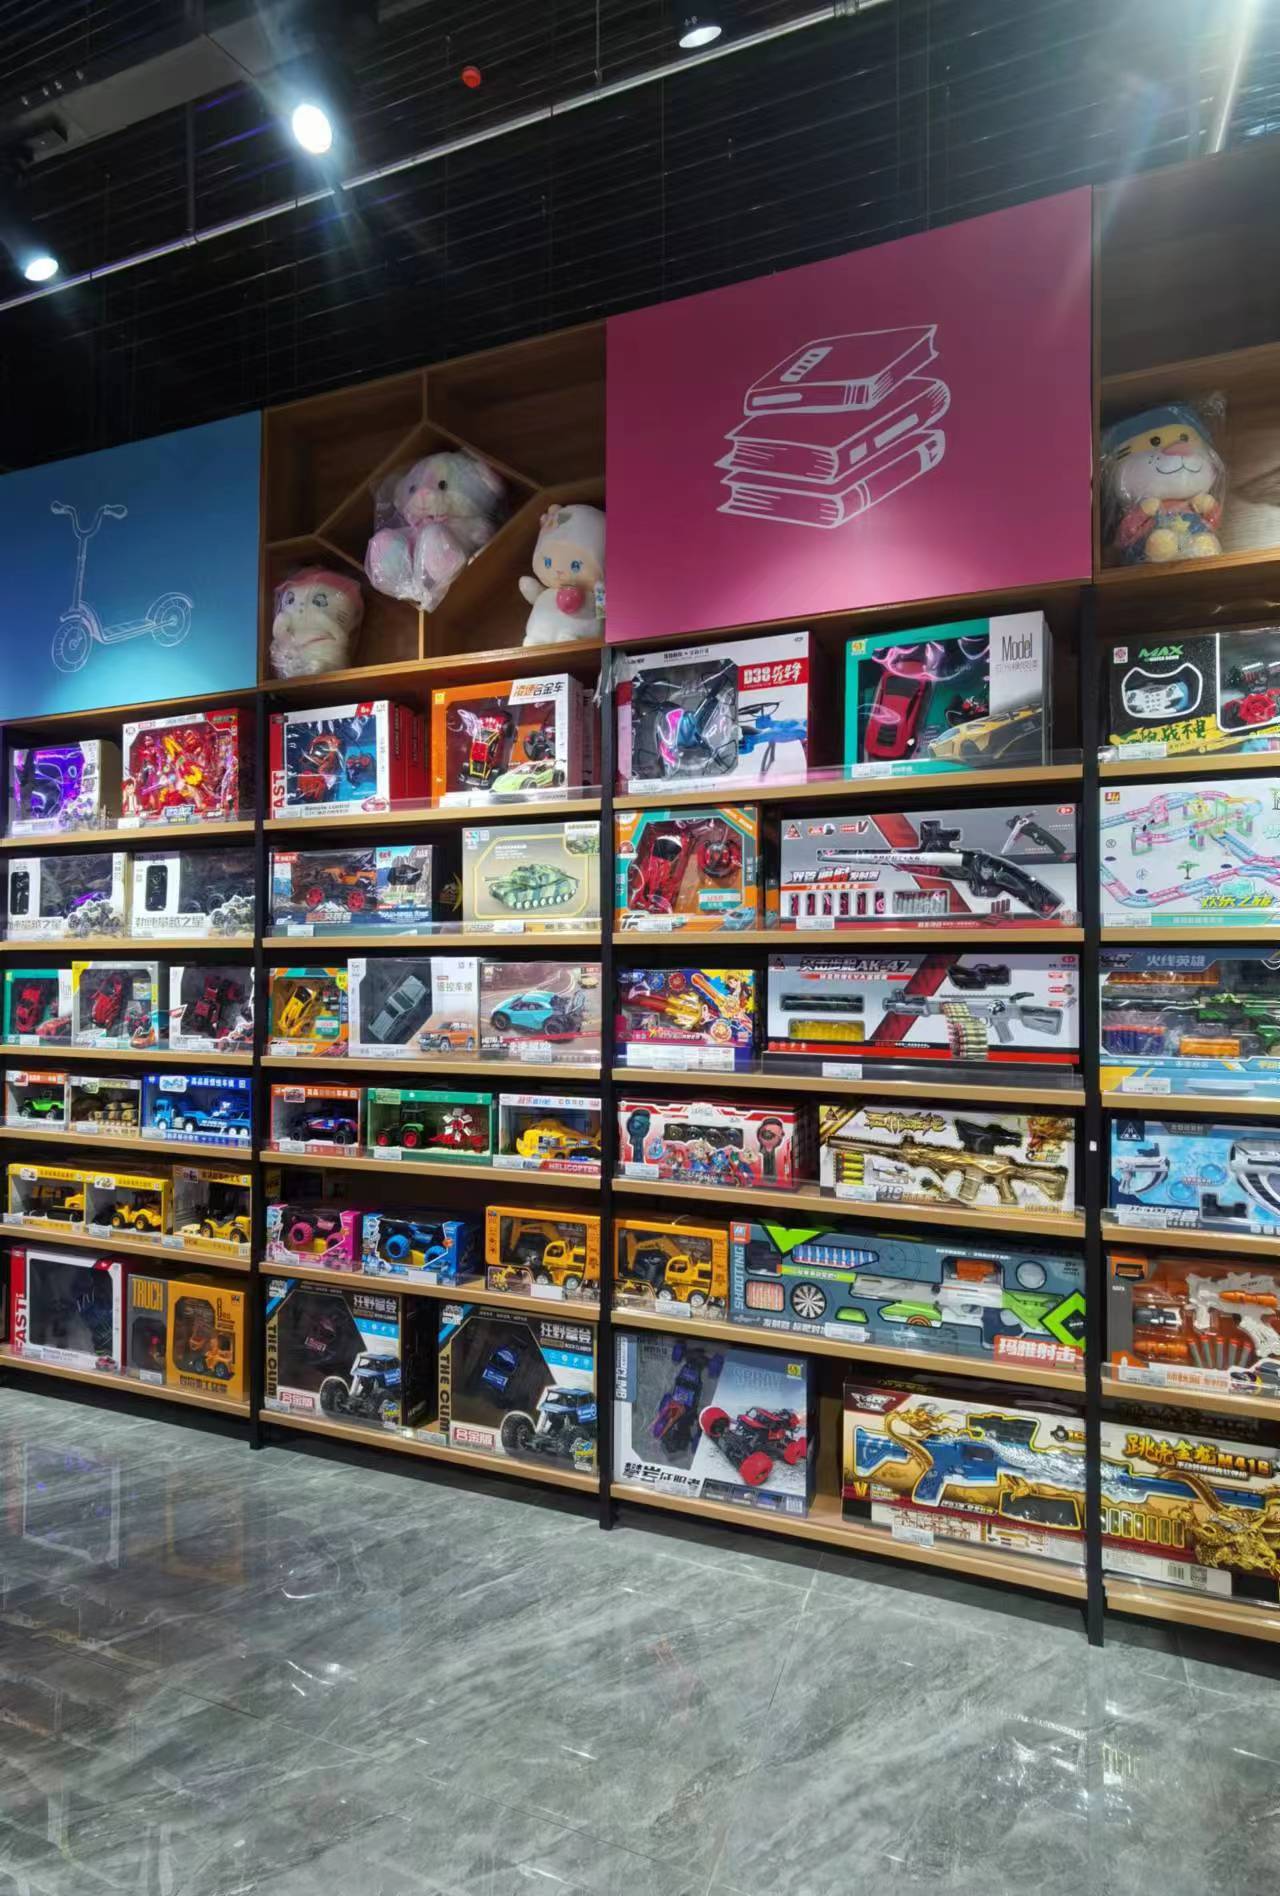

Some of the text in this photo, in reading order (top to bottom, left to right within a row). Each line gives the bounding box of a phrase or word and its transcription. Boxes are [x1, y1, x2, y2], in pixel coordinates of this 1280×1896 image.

[1002, 633, 1032, 661] Model
[856, 959, 910, 971] AK-47
[1147, 955, 1206, 968] 火线英雄
[548, 1162, 599, 1174] HELICOPTER
[734, 1246, 745, 1310] SHOOTING
[267, 1325, 278, 1352] THE
[439, 1354, 450, 1384] THE
[616, 1368, 627, 1399] CLIMB
[456, 1428, 493, 1445] 合金版
